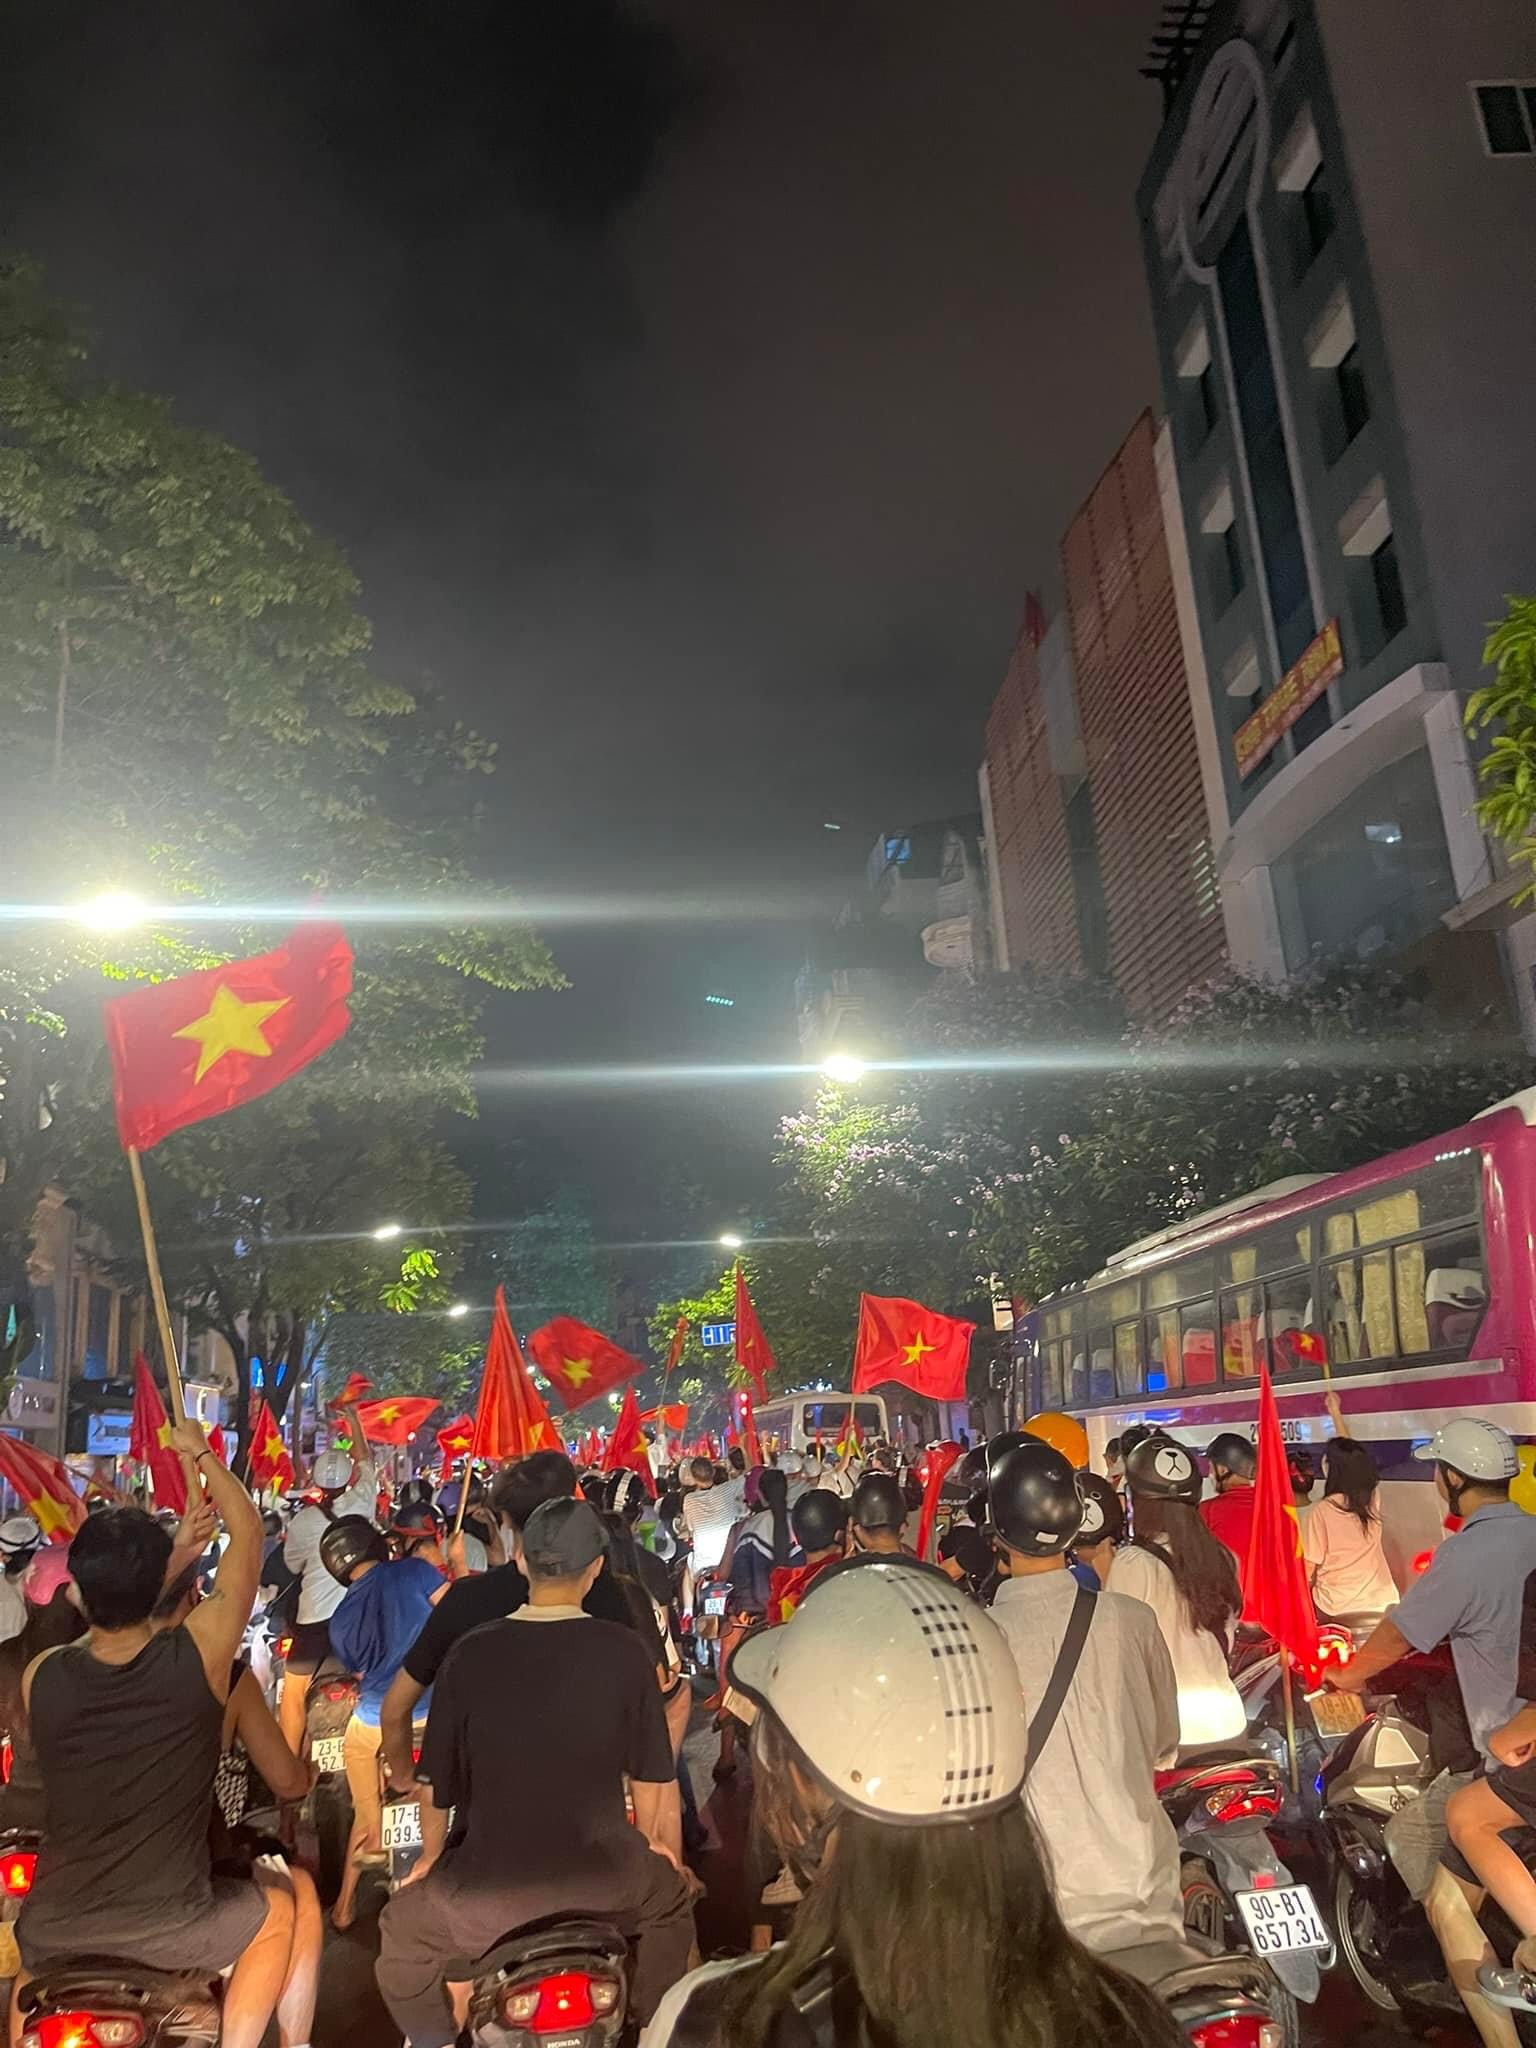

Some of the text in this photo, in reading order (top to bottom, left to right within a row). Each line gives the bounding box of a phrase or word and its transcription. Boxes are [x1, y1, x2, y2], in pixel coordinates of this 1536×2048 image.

[391, 1805, 421, 1825] 17-B
[384, 1823, 423, 1846] 039.3
[1249, 1891, 1306, 1920] 90-B1
[1253, 1917, 1324, 1950] 657.34
[547, 2038, 580, 2048] HONDA
